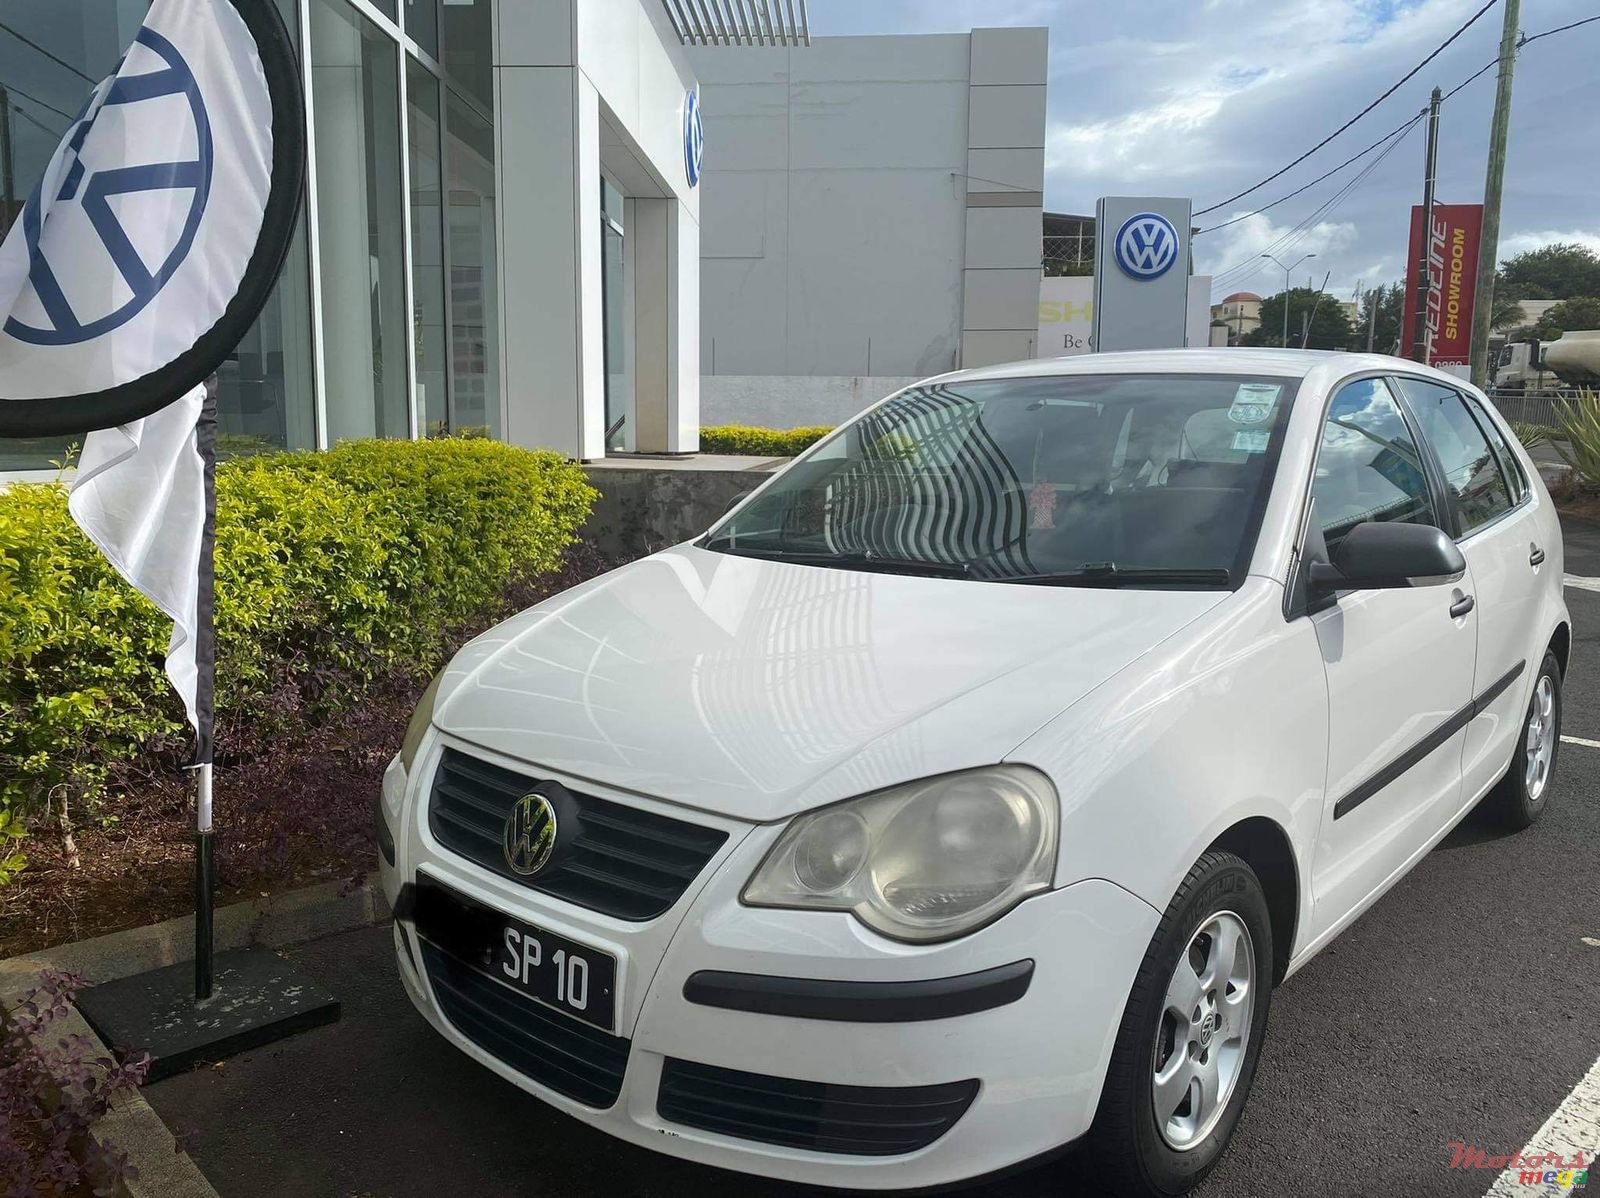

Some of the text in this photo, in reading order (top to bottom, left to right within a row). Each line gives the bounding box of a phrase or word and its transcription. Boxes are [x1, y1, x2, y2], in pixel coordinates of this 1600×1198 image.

[1445, 228, 1465, 340] SHOWROOM
[1063, 334, 1083, 349] Be
[502, 926, 589, 1011] SP 10
